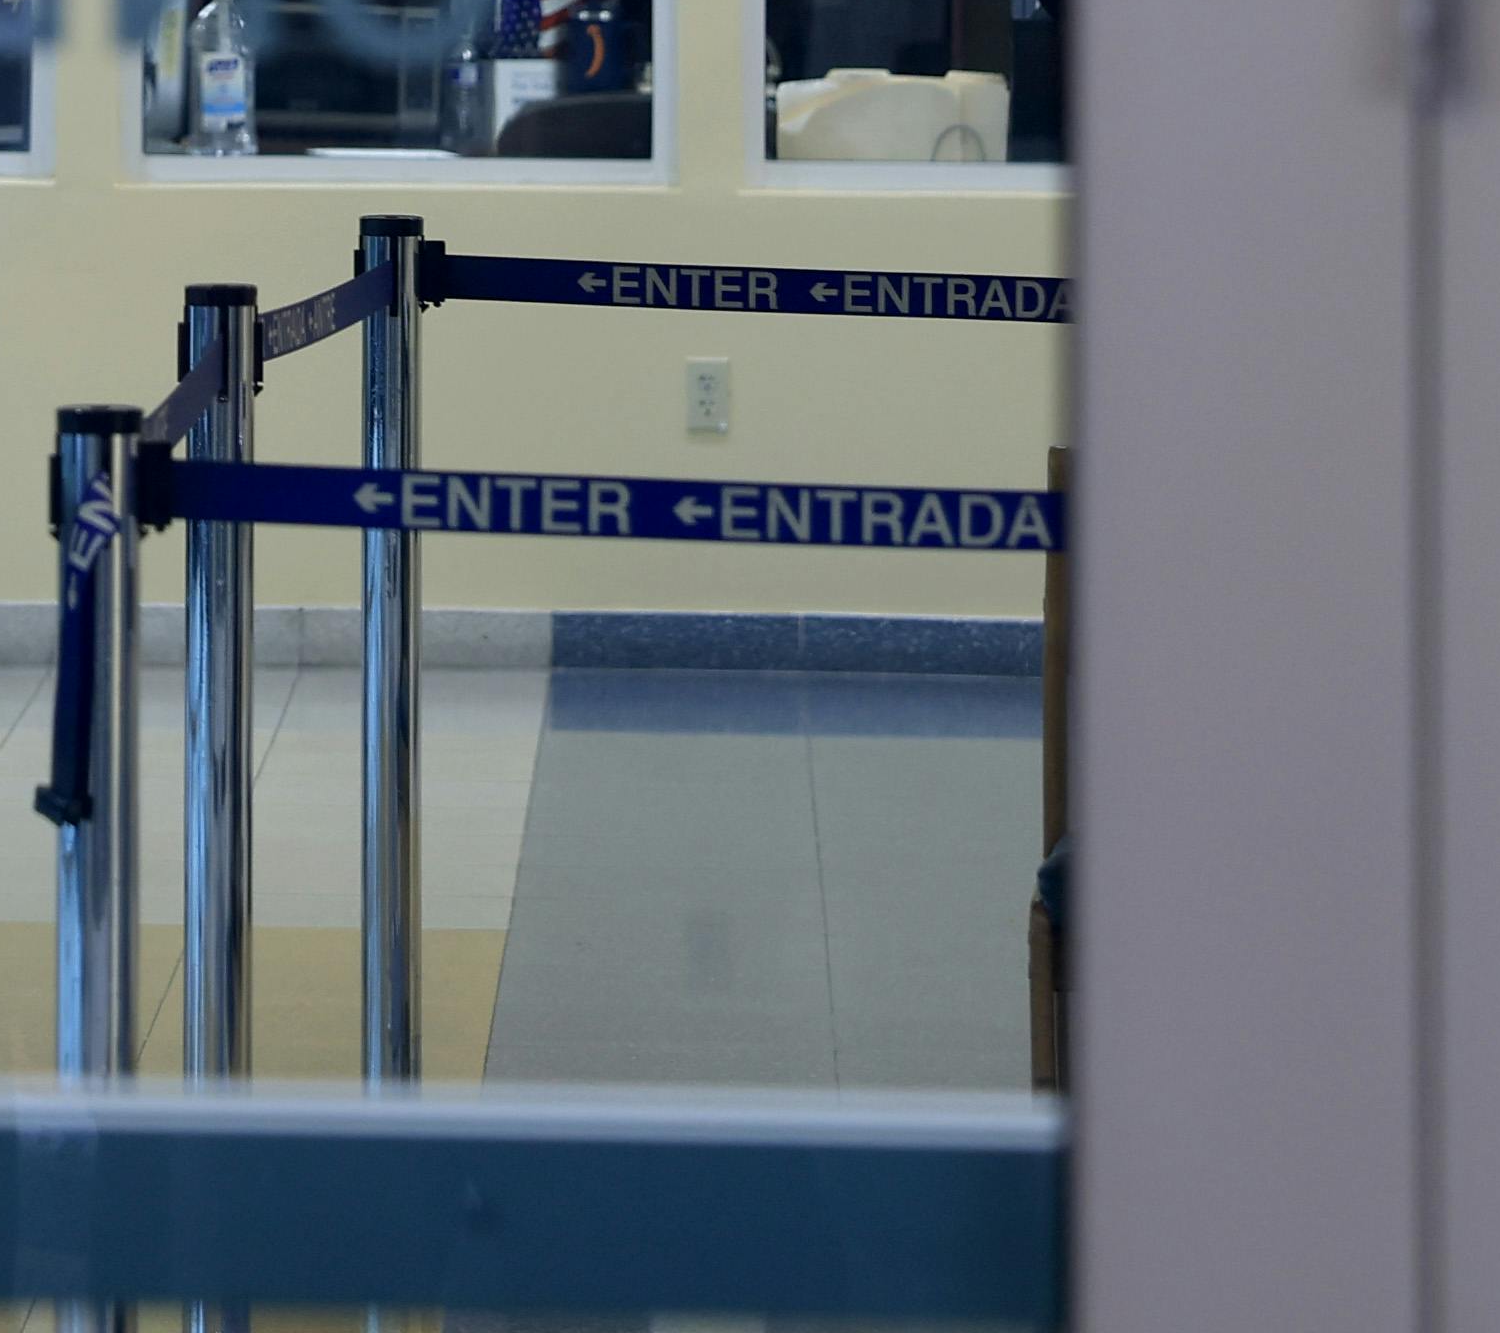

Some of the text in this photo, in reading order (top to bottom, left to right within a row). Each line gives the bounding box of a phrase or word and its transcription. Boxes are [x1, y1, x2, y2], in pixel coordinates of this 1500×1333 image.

[610, 265, 1077, 321] ENTER ENTRADA
[400, 472, 1053, 549] ENTER ENTRADA
